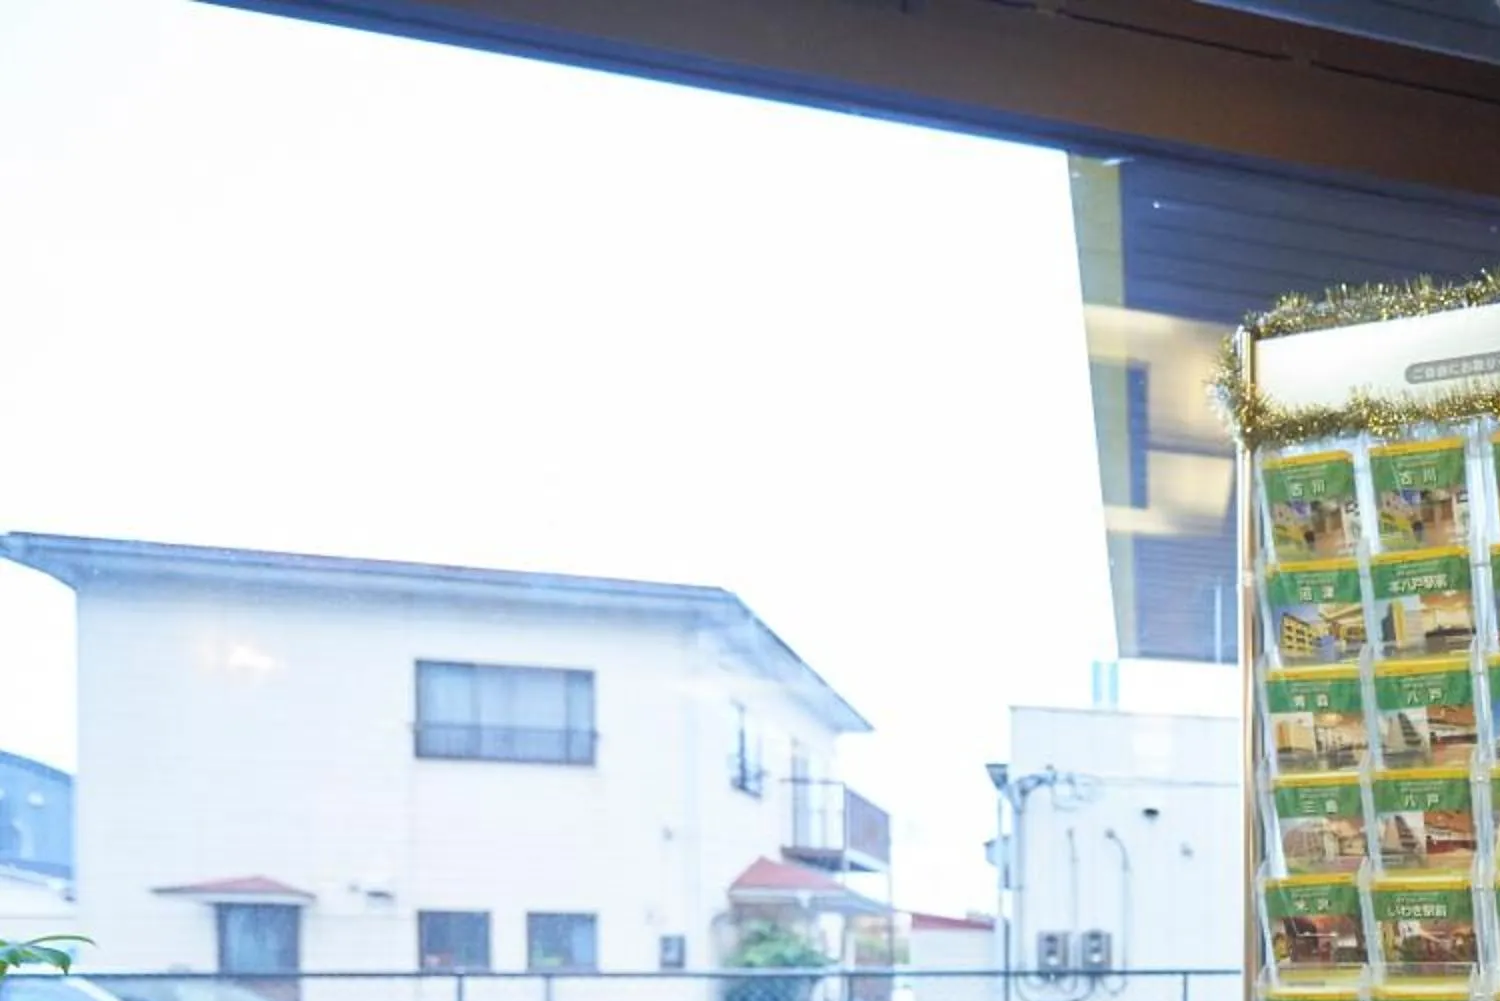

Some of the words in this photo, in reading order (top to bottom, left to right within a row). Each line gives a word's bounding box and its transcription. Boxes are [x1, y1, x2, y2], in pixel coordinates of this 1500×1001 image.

[1399, 466, 1437, 486] 古川
[1407, 687, 1442, 704] 八戸
[1404, 792, 1439, 808] 八戸
